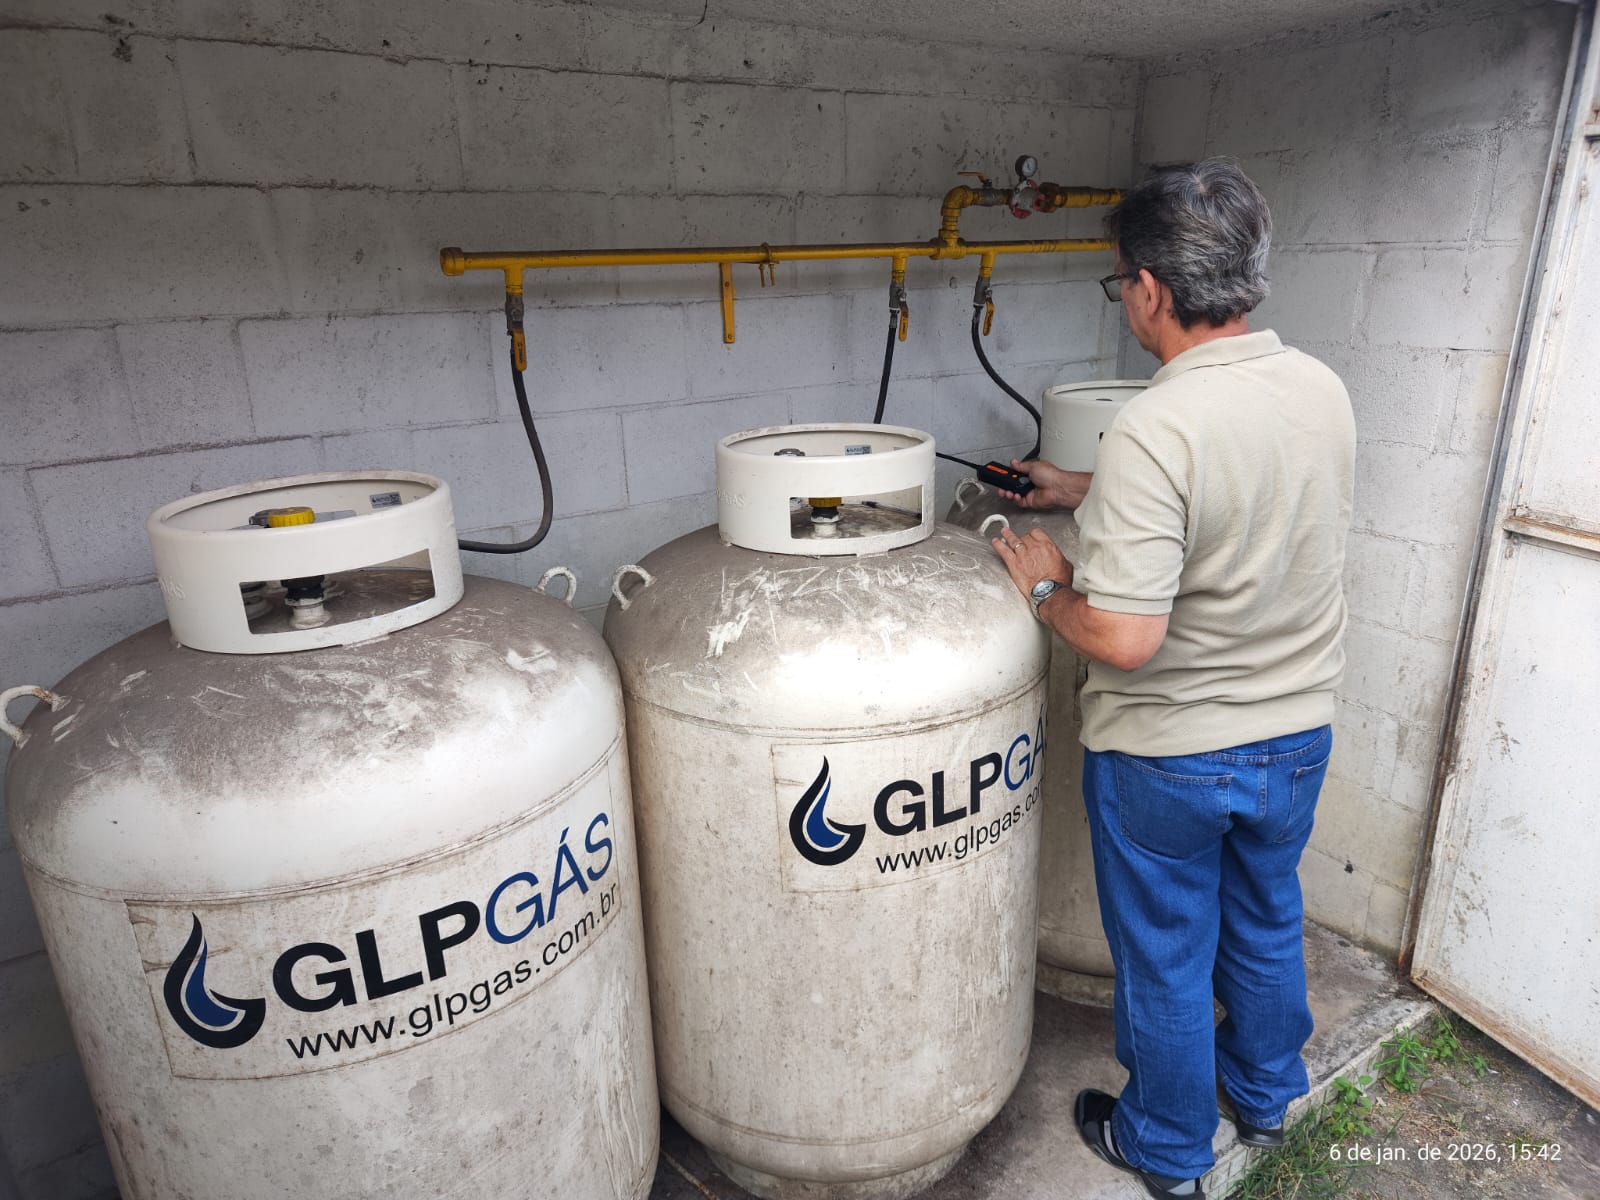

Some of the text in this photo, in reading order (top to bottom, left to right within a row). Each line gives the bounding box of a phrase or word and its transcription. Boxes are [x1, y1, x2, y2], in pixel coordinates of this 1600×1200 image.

[872, 702, 1048, 836] GLPGÁ
[272, 812, 613, 1013] GLPGÁS
[286, 881, 618, 1059] www.glpgas.com.br
